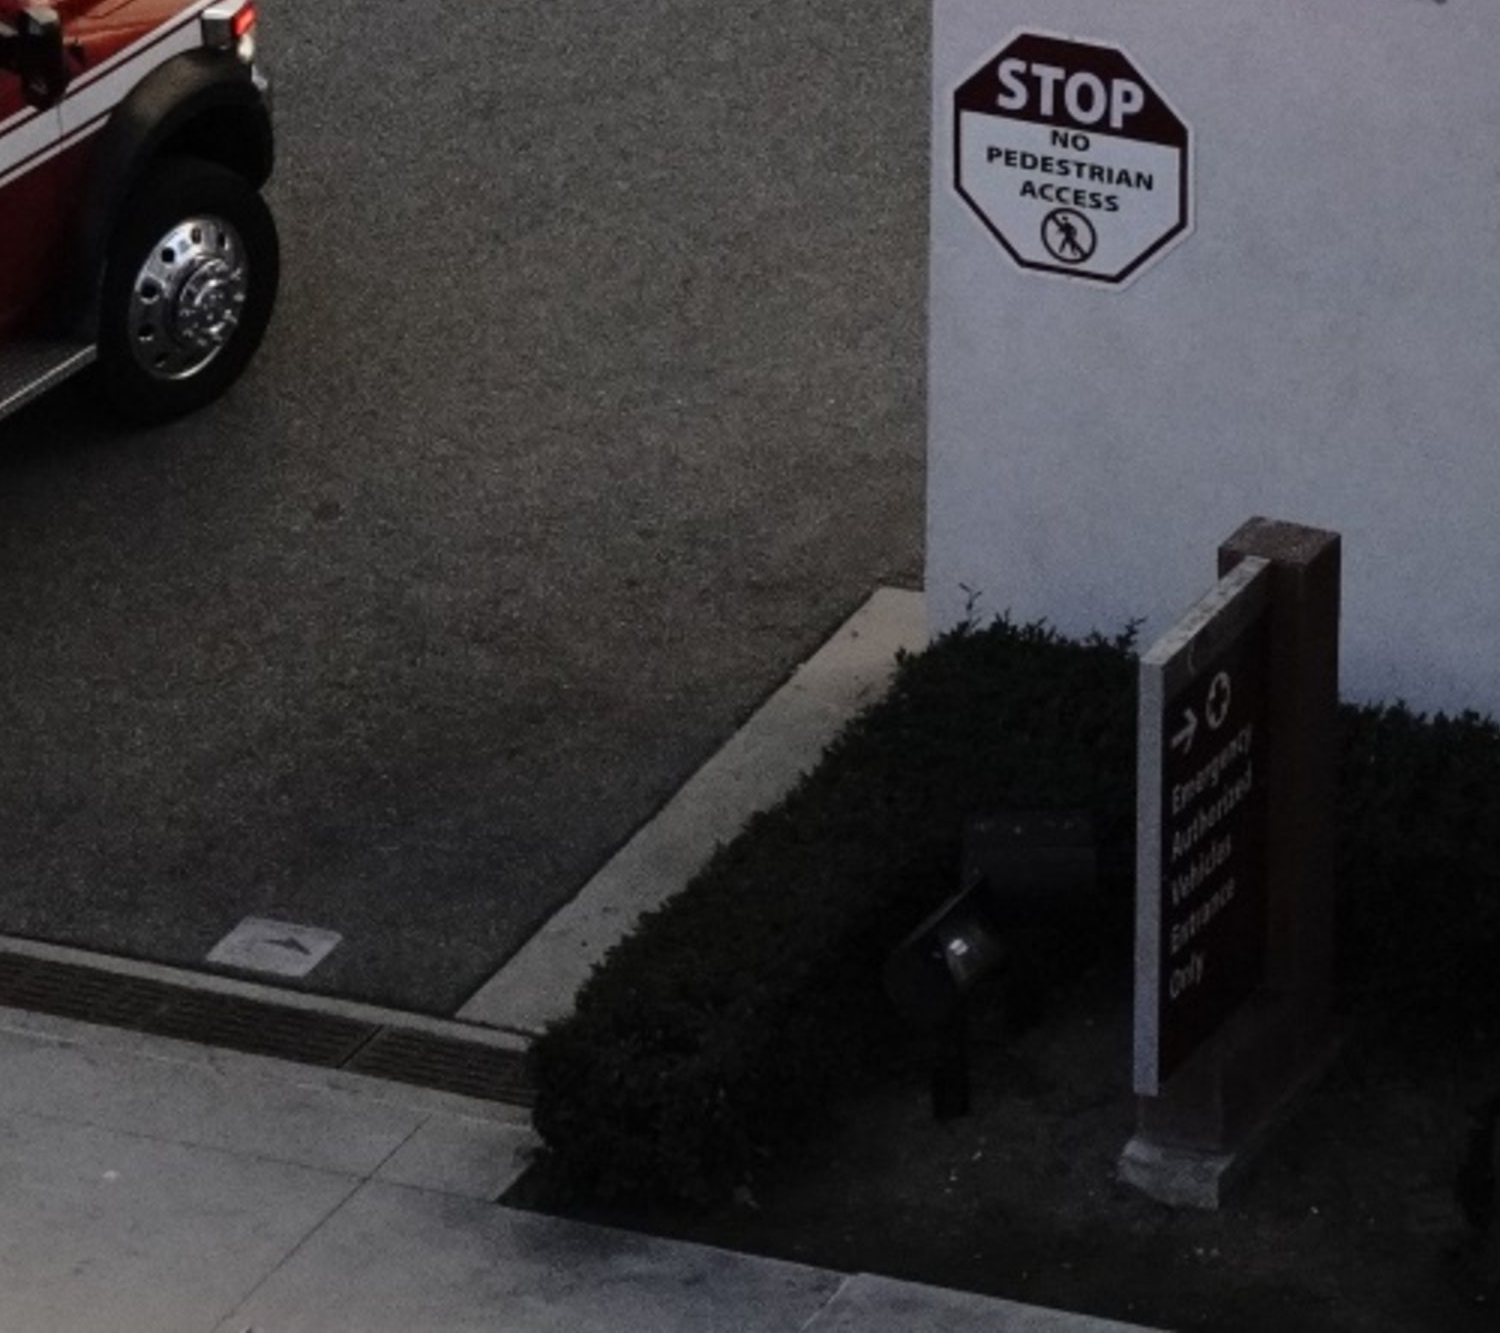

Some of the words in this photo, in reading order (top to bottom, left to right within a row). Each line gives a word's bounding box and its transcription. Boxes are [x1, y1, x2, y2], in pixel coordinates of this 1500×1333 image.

[996, 58, 1145, 128] STOP
[986, 146, 1153, 191] PEDESTRIAN
[1051, 130, 1090, 151] NO
[1020, 180, 1120, 212] ACCESS
[1171, 722, 1251, 816] Emergency
[1171, 757, 1252, 862] Authorized
